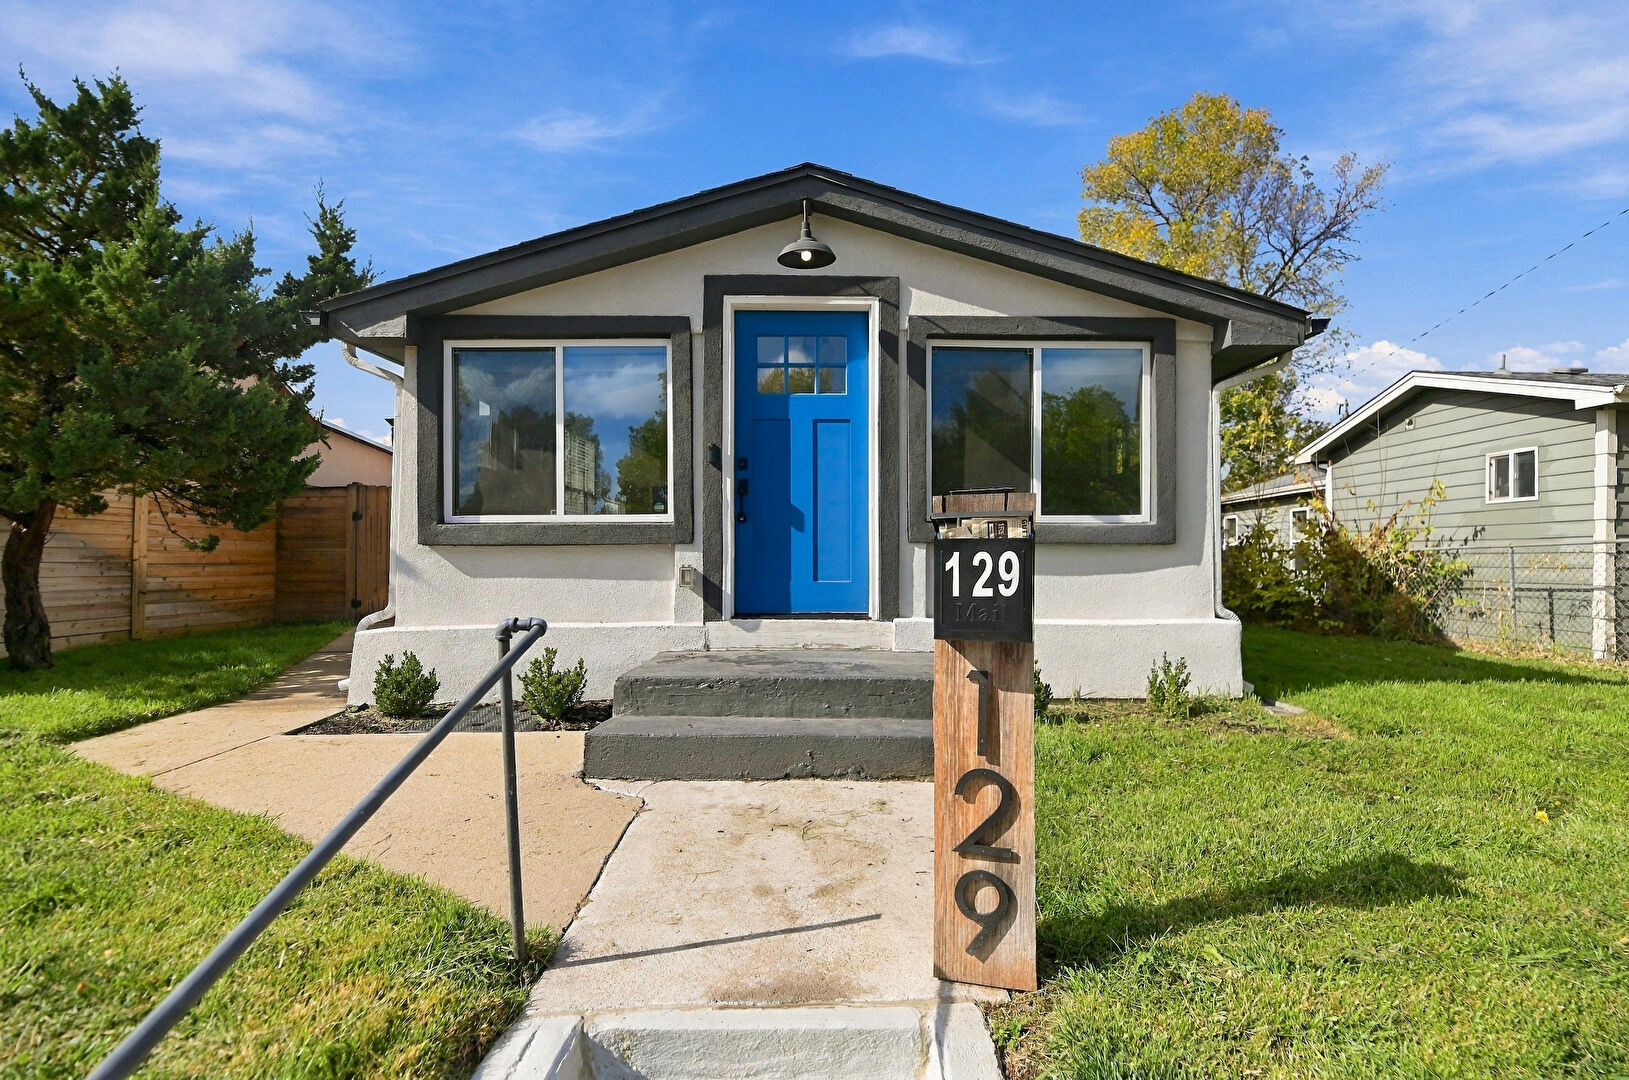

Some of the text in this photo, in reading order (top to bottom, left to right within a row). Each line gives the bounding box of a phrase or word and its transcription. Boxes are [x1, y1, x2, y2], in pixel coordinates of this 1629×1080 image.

[945, 550, 1020, 597] 129
[952, 602, 1007, 622] Mail
[952, 669, 1013, 955] 129
